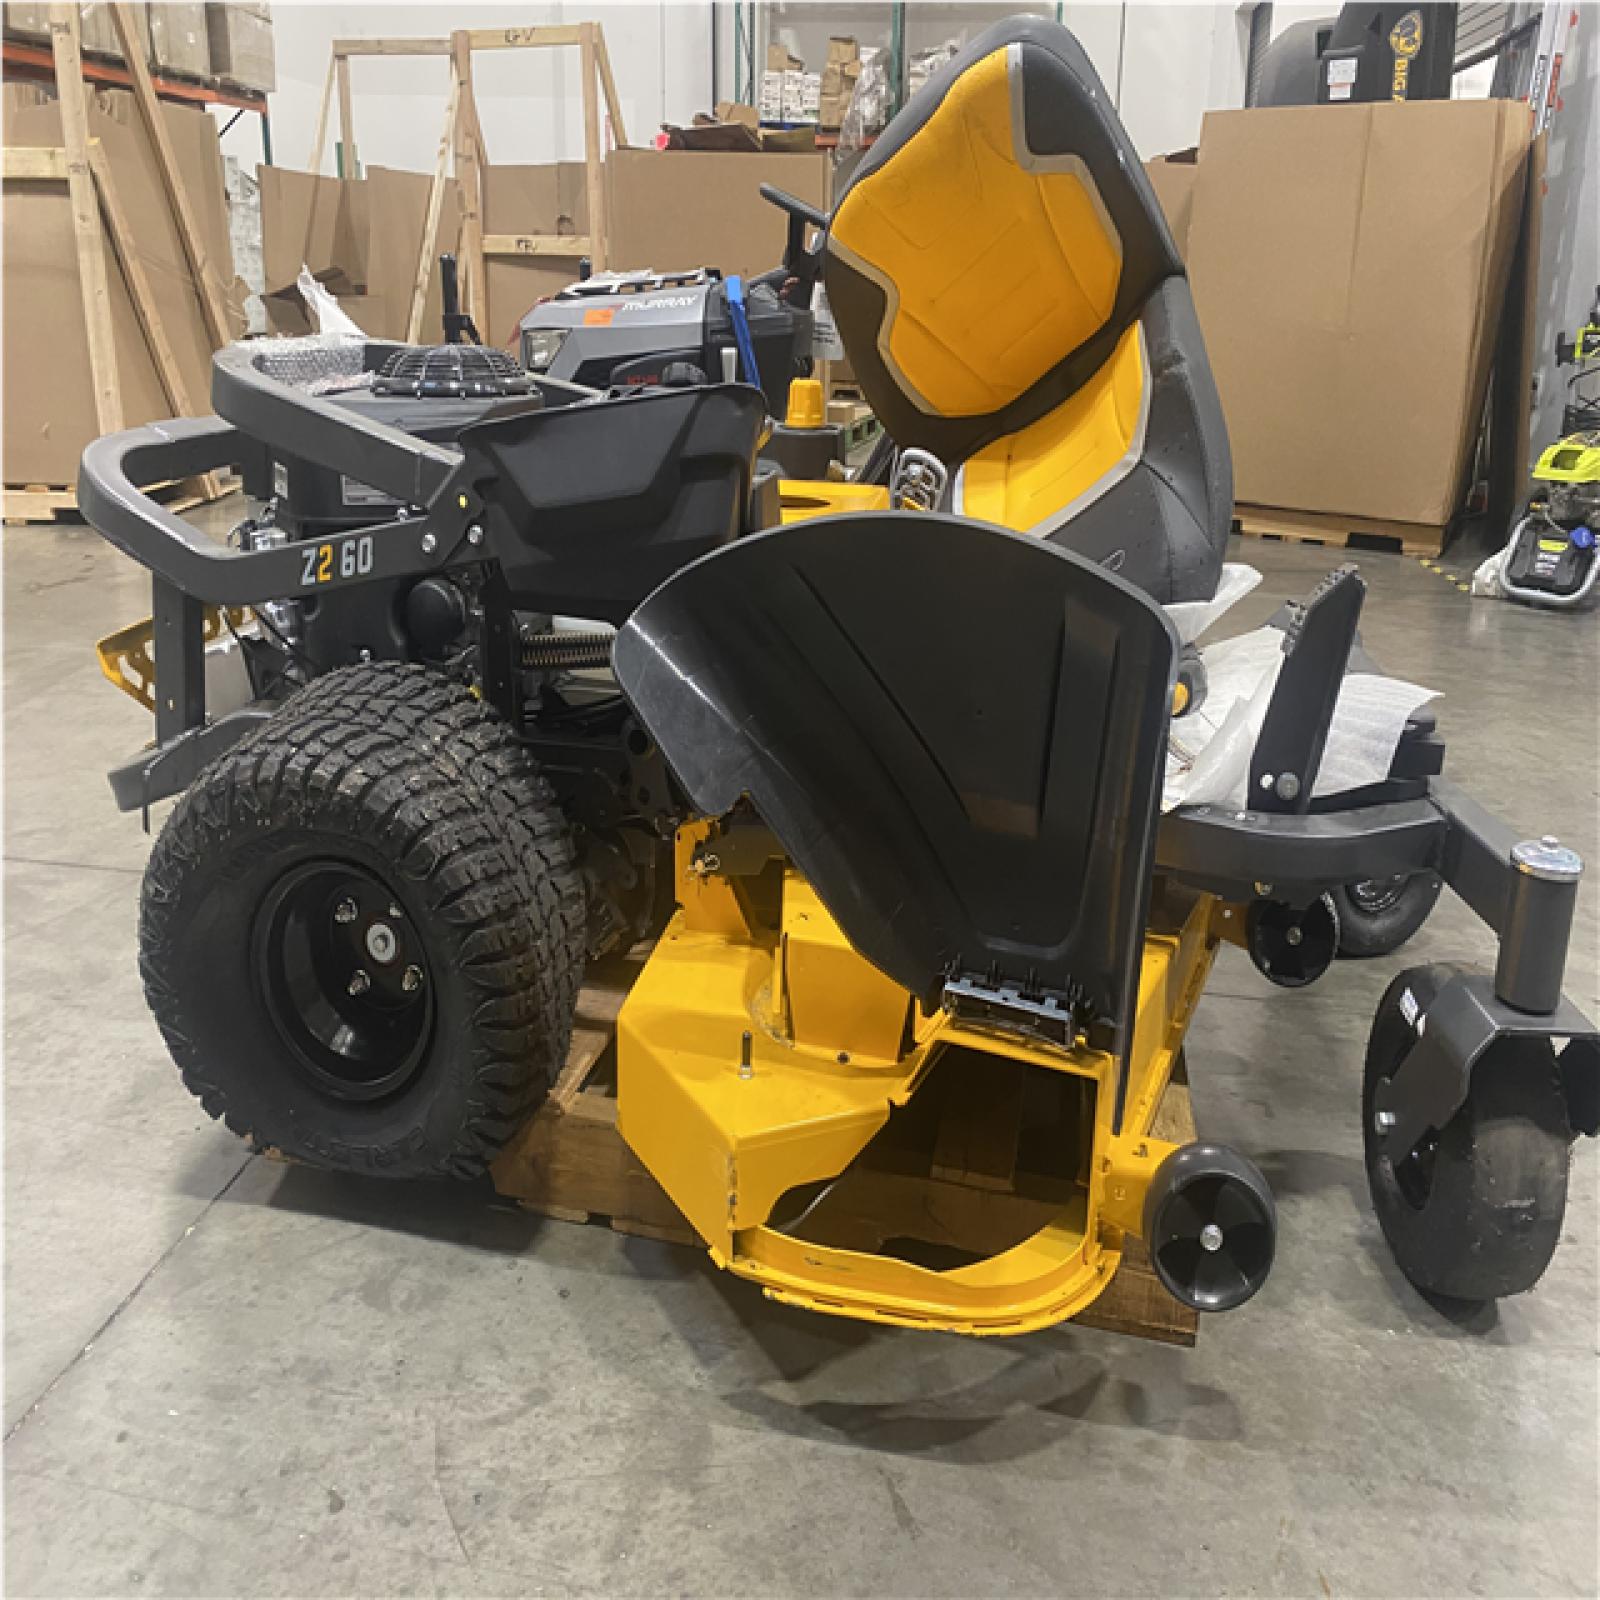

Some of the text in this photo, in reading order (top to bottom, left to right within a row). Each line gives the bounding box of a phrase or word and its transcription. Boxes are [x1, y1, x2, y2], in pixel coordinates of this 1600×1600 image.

[1392, 58, 1409, 91] BIG
[301, 536, 373, 586] Z2 60
